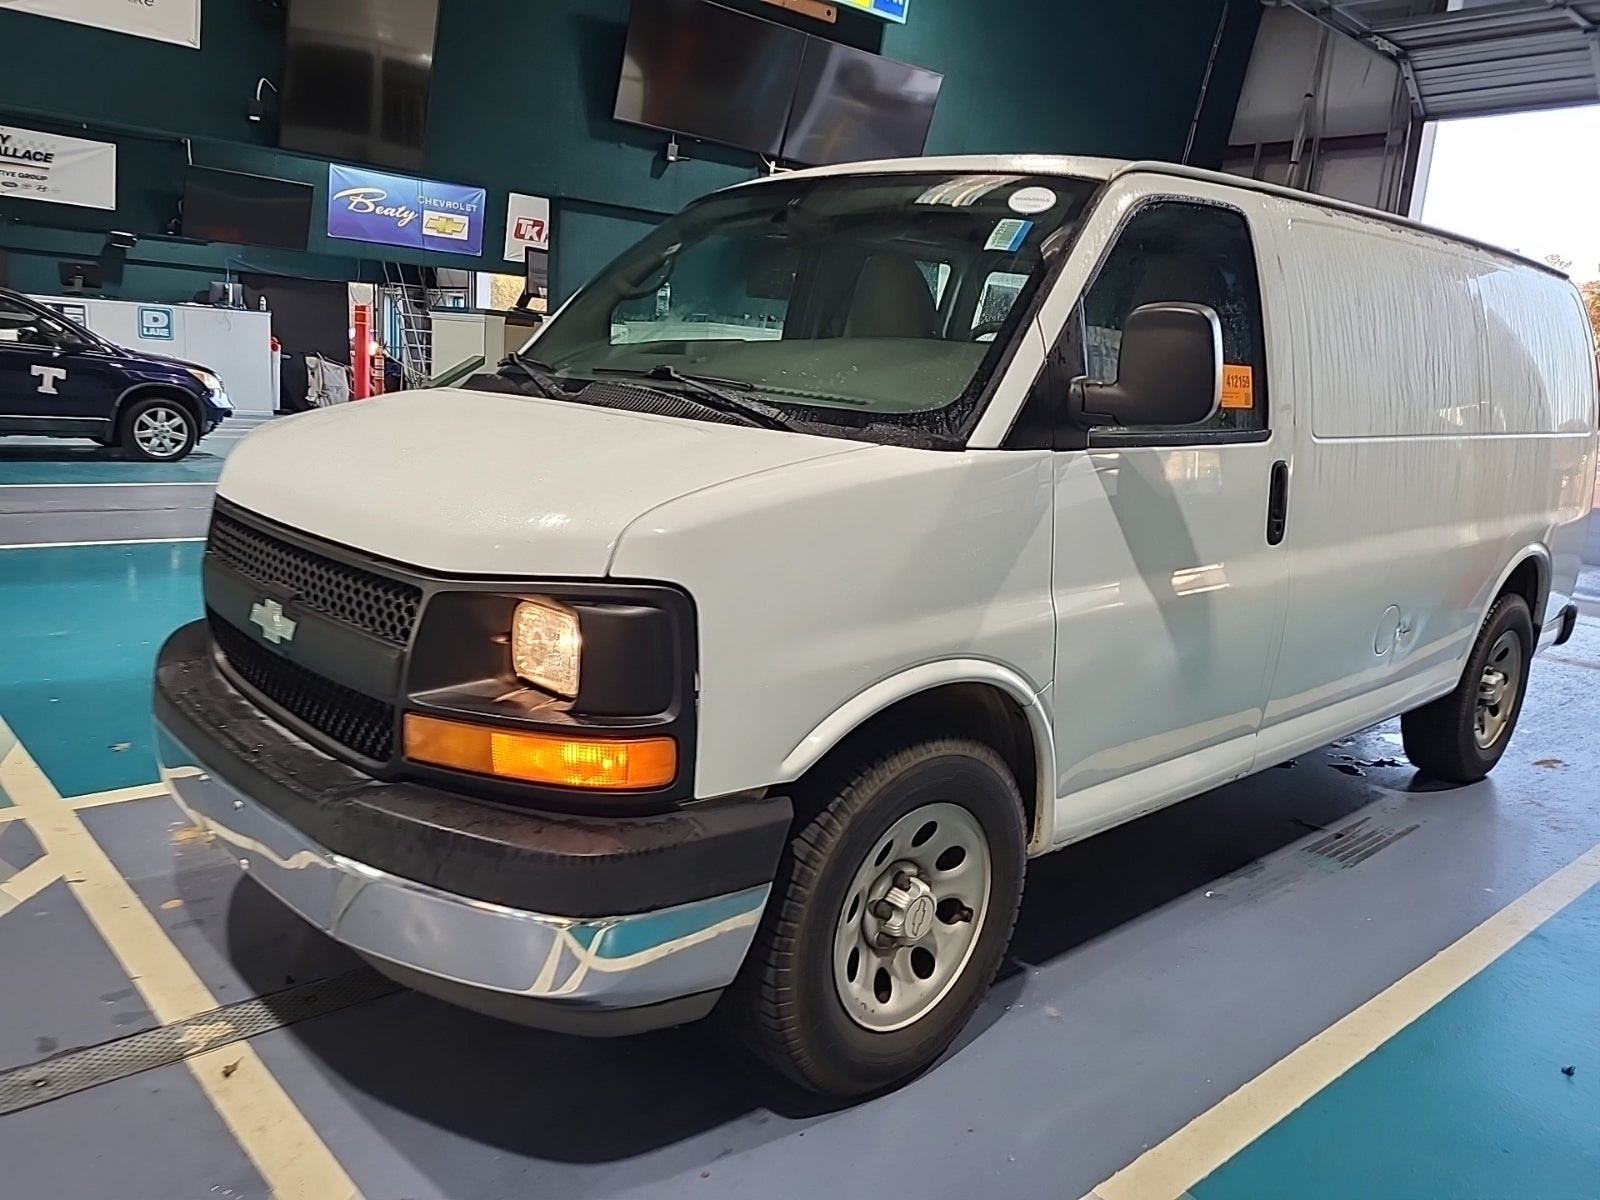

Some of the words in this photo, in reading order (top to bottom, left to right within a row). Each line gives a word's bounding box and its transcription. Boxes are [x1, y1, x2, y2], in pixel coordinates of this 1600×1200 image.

[333, 187, 418, 227] Beaty
[417, 195, 478, 212] CHEVROLET
[143, 310, 169, 327] D
[143, 327, 170, 337] LANE
[31, 365, 67, 395] T
[1226, 374, 1250, 389] 412159
